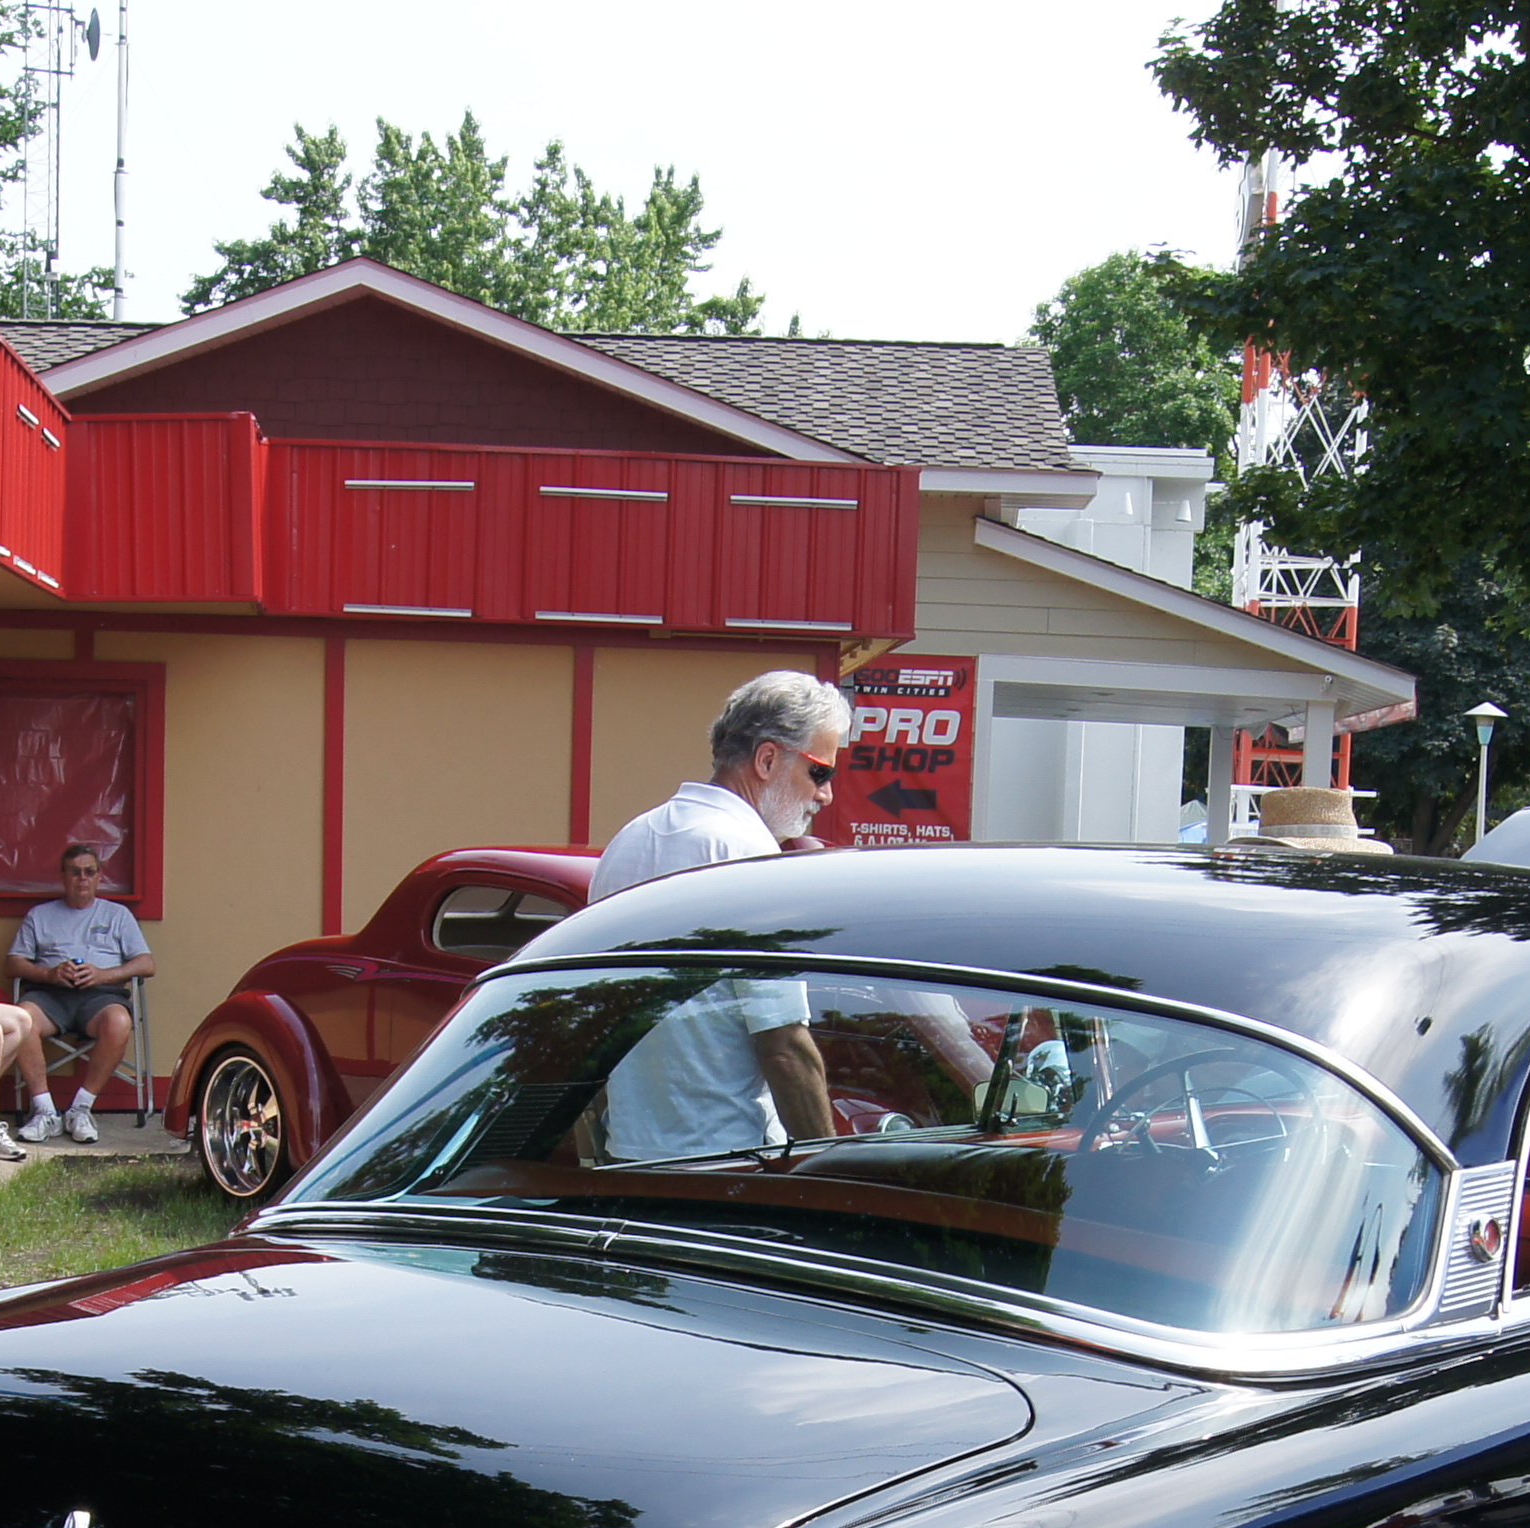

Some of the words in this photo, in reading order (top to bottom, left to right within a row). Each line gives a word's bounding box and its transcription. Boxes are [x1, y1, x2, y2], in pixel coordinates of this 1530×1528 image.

[898, 669, 954, 686] ESPN
[854, 685, 888, 694] TWIN
[897, 687, 946, 696] CITIES
[850, 706, 961, 745] PRO
[849, 745, 956, 773] SHOP
[850, 822, 912, 838] T-SHIRTS,
[916, 825, 954, 841] HATS,
